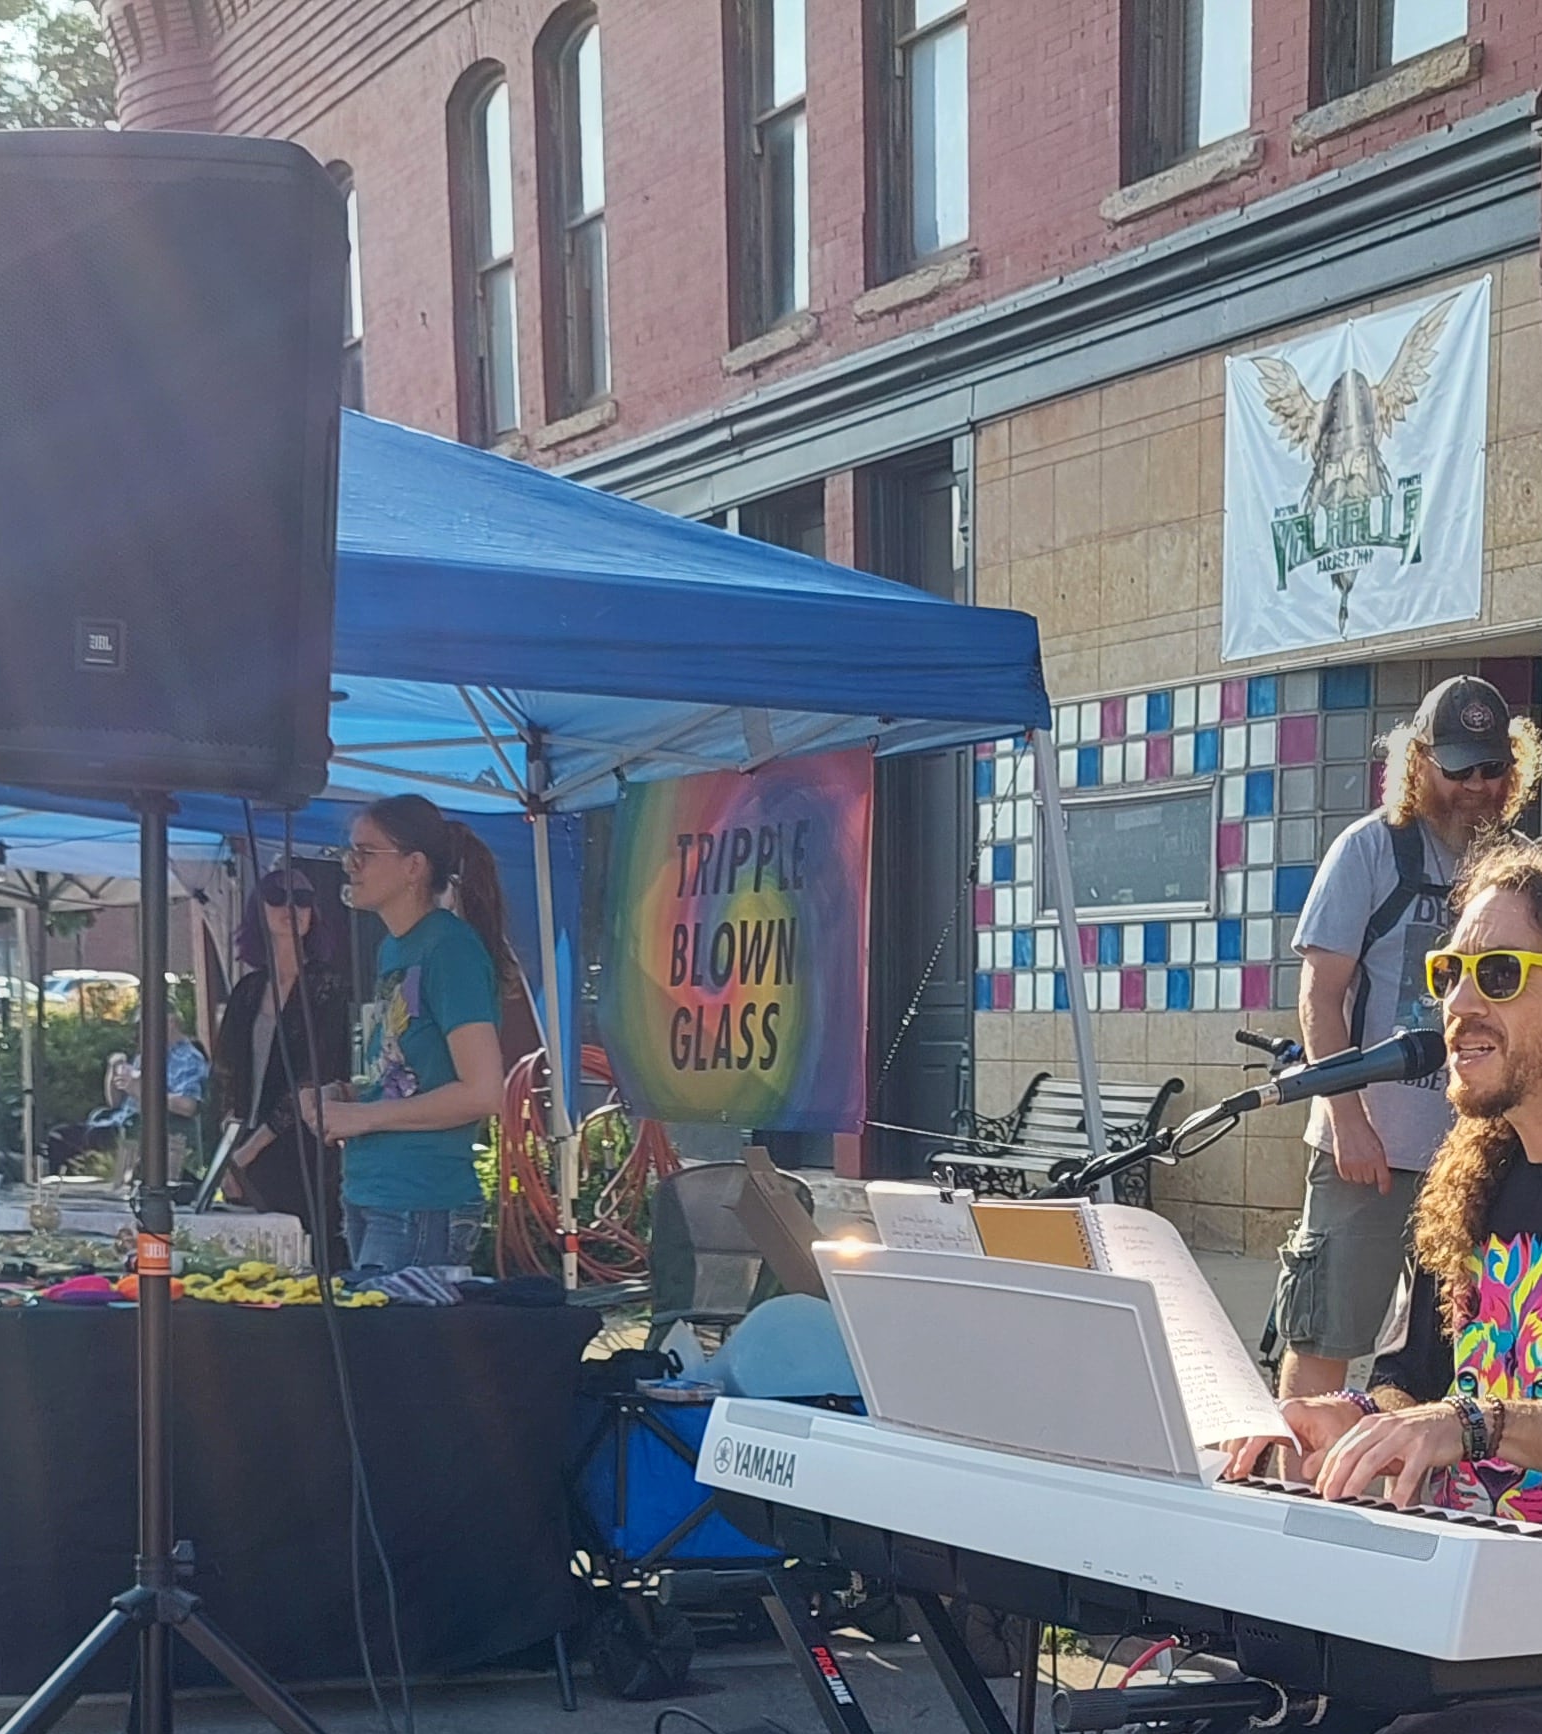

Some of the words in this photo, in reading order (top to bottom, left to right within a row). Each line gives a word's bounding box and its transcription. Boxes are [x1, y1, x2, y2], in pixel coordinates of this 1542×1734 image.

[1271, 487, 1422, 591] VALHALLA
[89, 634, 113, 651] JBL
[676, 819, 811, 898] TRIPPLE
[670, 918, 797, 987] BLOWN
[670, 1002, 780, 1071] GLASS
[733, 1441, 797, 1488] YAMAHA
[811, 1647, 854, 1705] PROLINE
